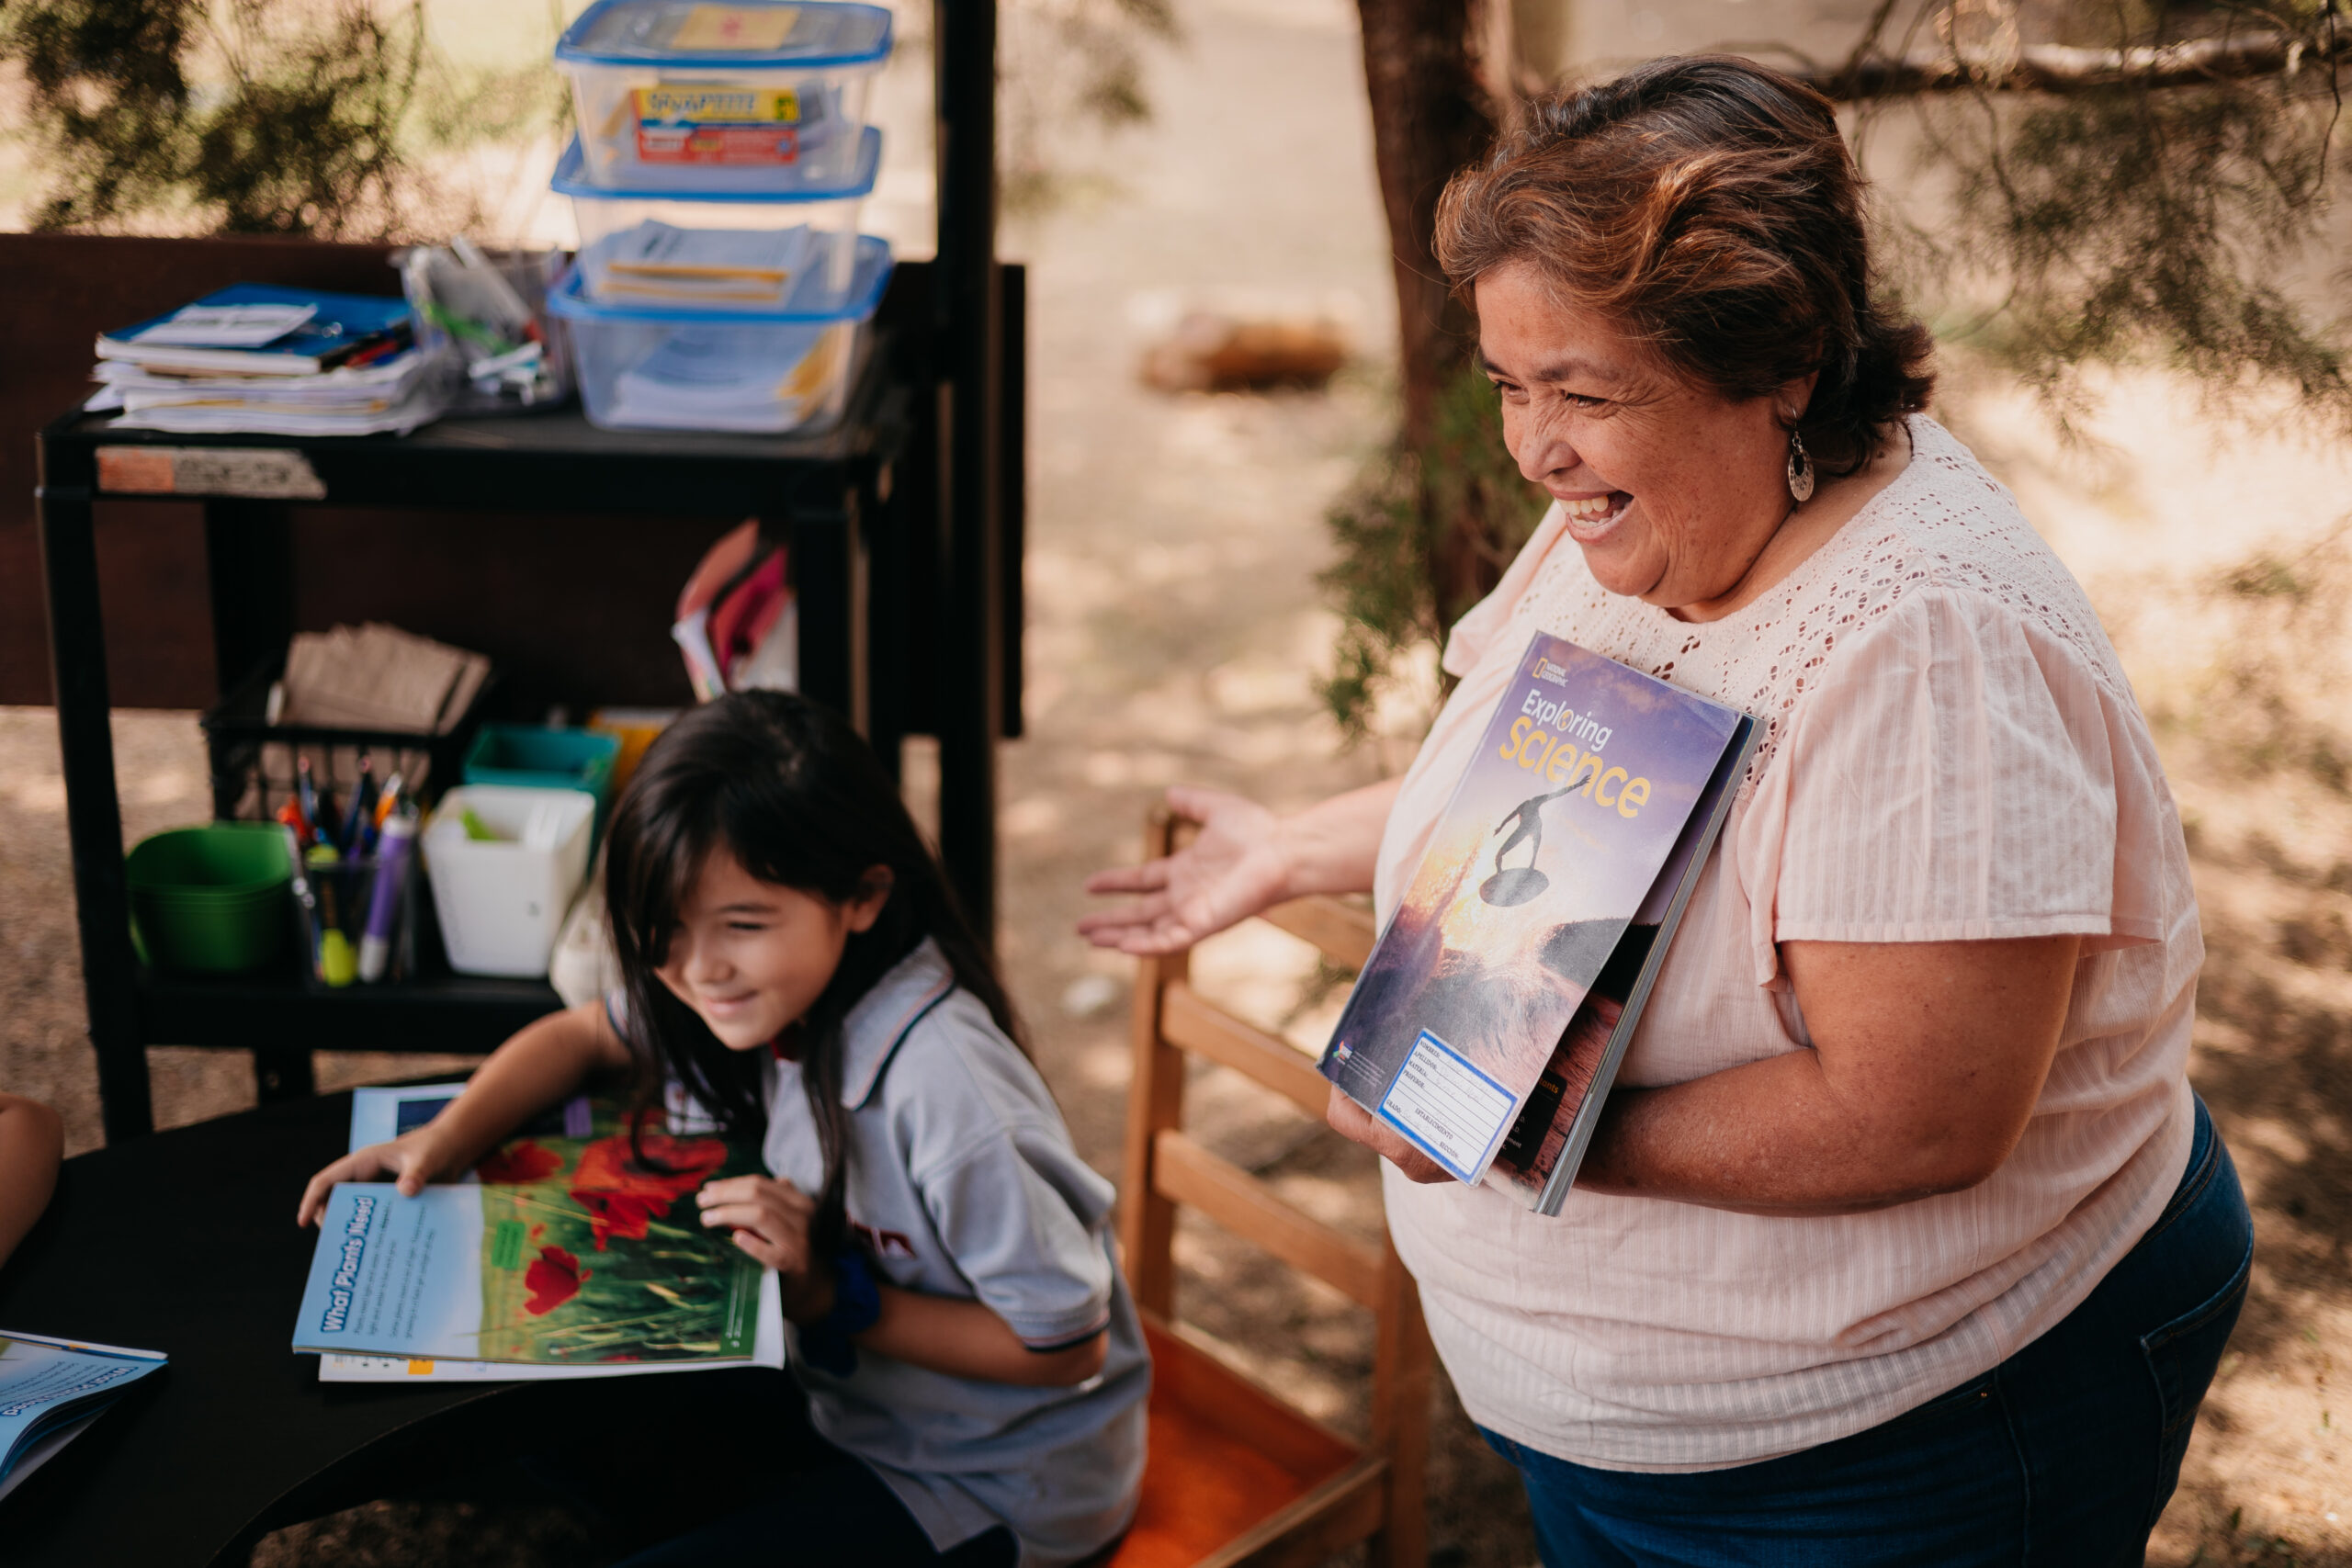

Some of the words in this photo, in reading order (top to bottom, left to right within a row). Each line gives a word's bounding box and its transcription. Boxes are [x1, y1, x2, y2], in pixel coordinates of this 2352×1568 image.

[1521, 689, 1613, 752] Exploring
[346, 1196, 376, 1235] Need
[333, 1236, 366, 1288] Plants
[322, 1288, 352, 1332] What
